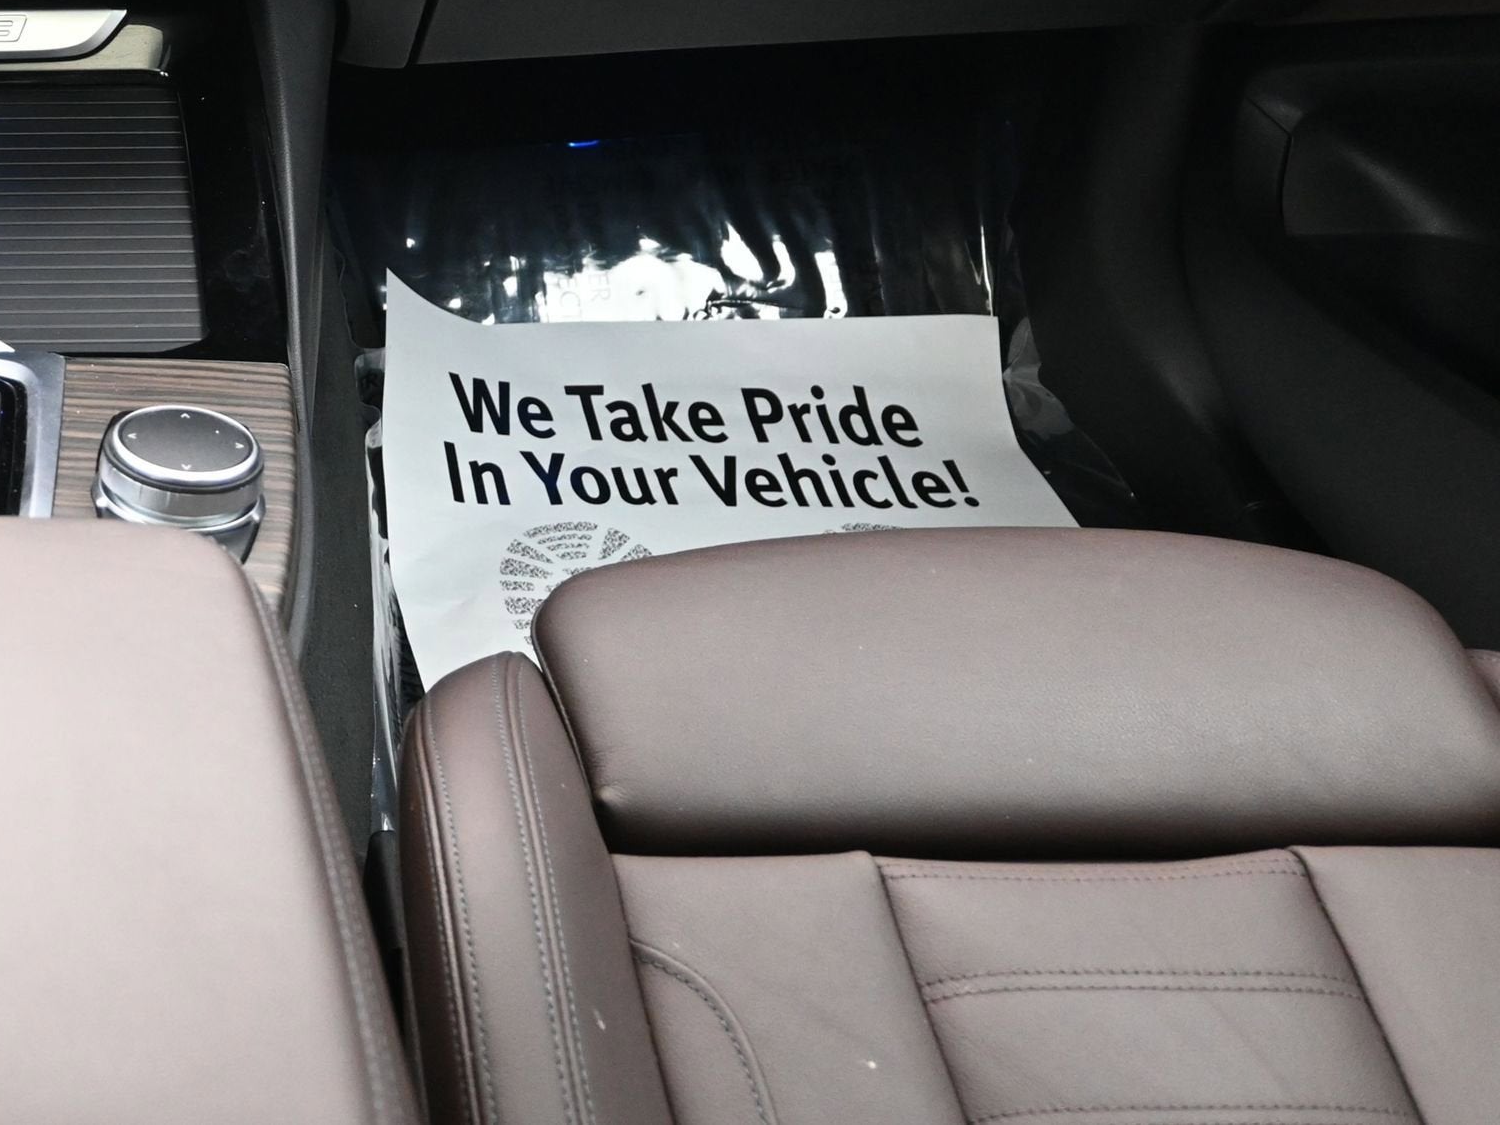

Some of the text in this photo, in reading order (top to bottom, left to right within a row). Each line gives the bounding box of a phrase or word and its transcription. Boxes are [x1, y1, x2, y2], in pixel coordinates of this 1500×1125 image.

[448, 371, 924, 449] We Take Pride
[443, 441, 981, 512] In Your Vehicle!
